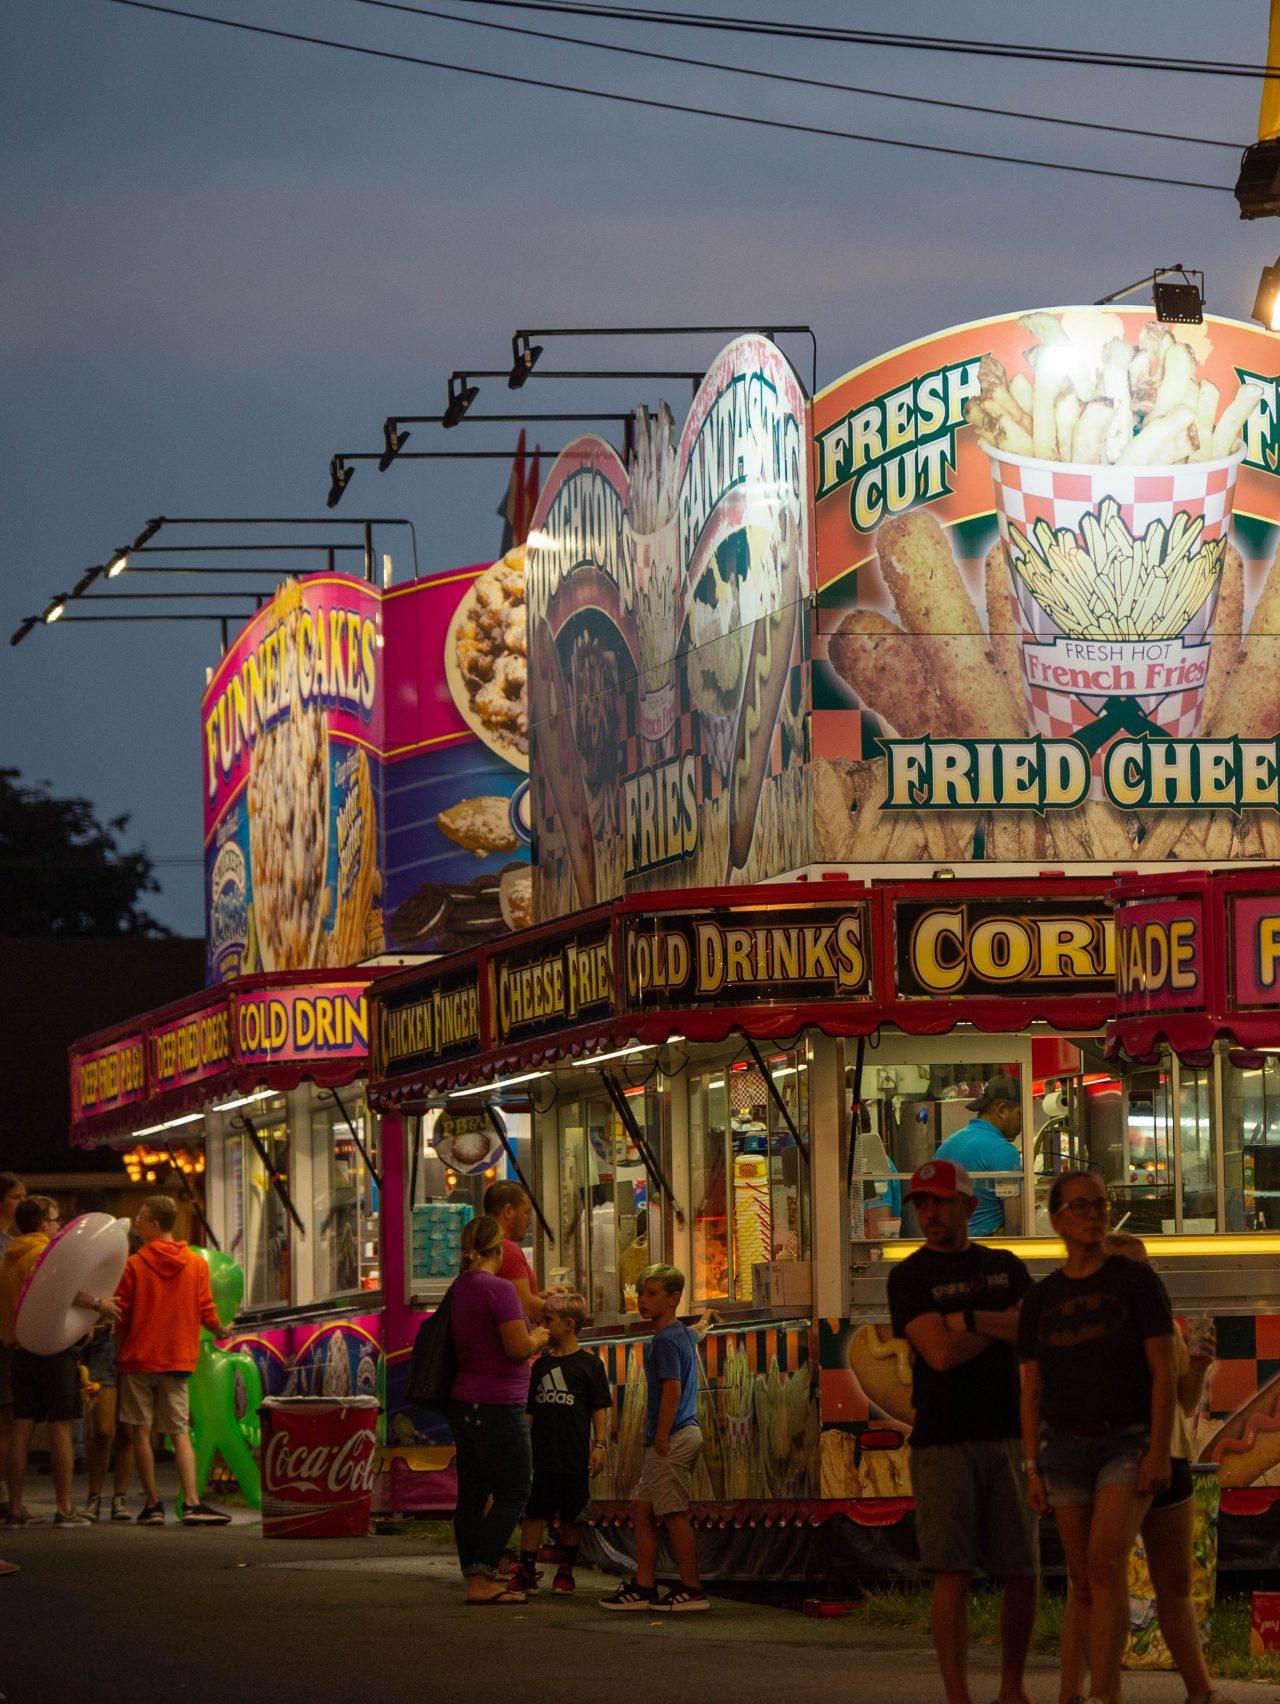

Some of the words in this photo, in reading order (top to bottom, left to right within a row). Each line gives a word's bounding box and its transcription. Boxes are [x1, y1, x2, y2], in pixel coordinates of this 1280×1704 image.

[819, 360, 984, 490] FRESH
[853, 441, 954, 528] CUT
[1028, 654, 1137, 691] French
[1146, 655, 1206, 690] Fries
[1065, 642, 1125, 662] FRESH
[1131, 642, 1173, 662] HOT
[206, 622, 291, 800] FUNNEL
[299, 607, 376, 714] CAKES
[889, 740, 1088, 806] FRIED
[625, 755, 698, 871] FRIES
[628, 931, 687, 997] COLD
[697, 913, 864, 993] DRINKS
[239, 1001, 287, 1051] COLD
[296, 998, 367, 1048] DRIN
[381, 1002, 432, 1069] CHICKEN
[434, 986, 480, 1055] FINGER
[500, 958, 563, 1035] CHEESE
[157, 1033, 176, 1080] DEEP
[177, 1022, 198, 1073] FRIED
[201, 1011, 228, 1065] OREOS
[442, 1113, 489, 1138] PB&J
